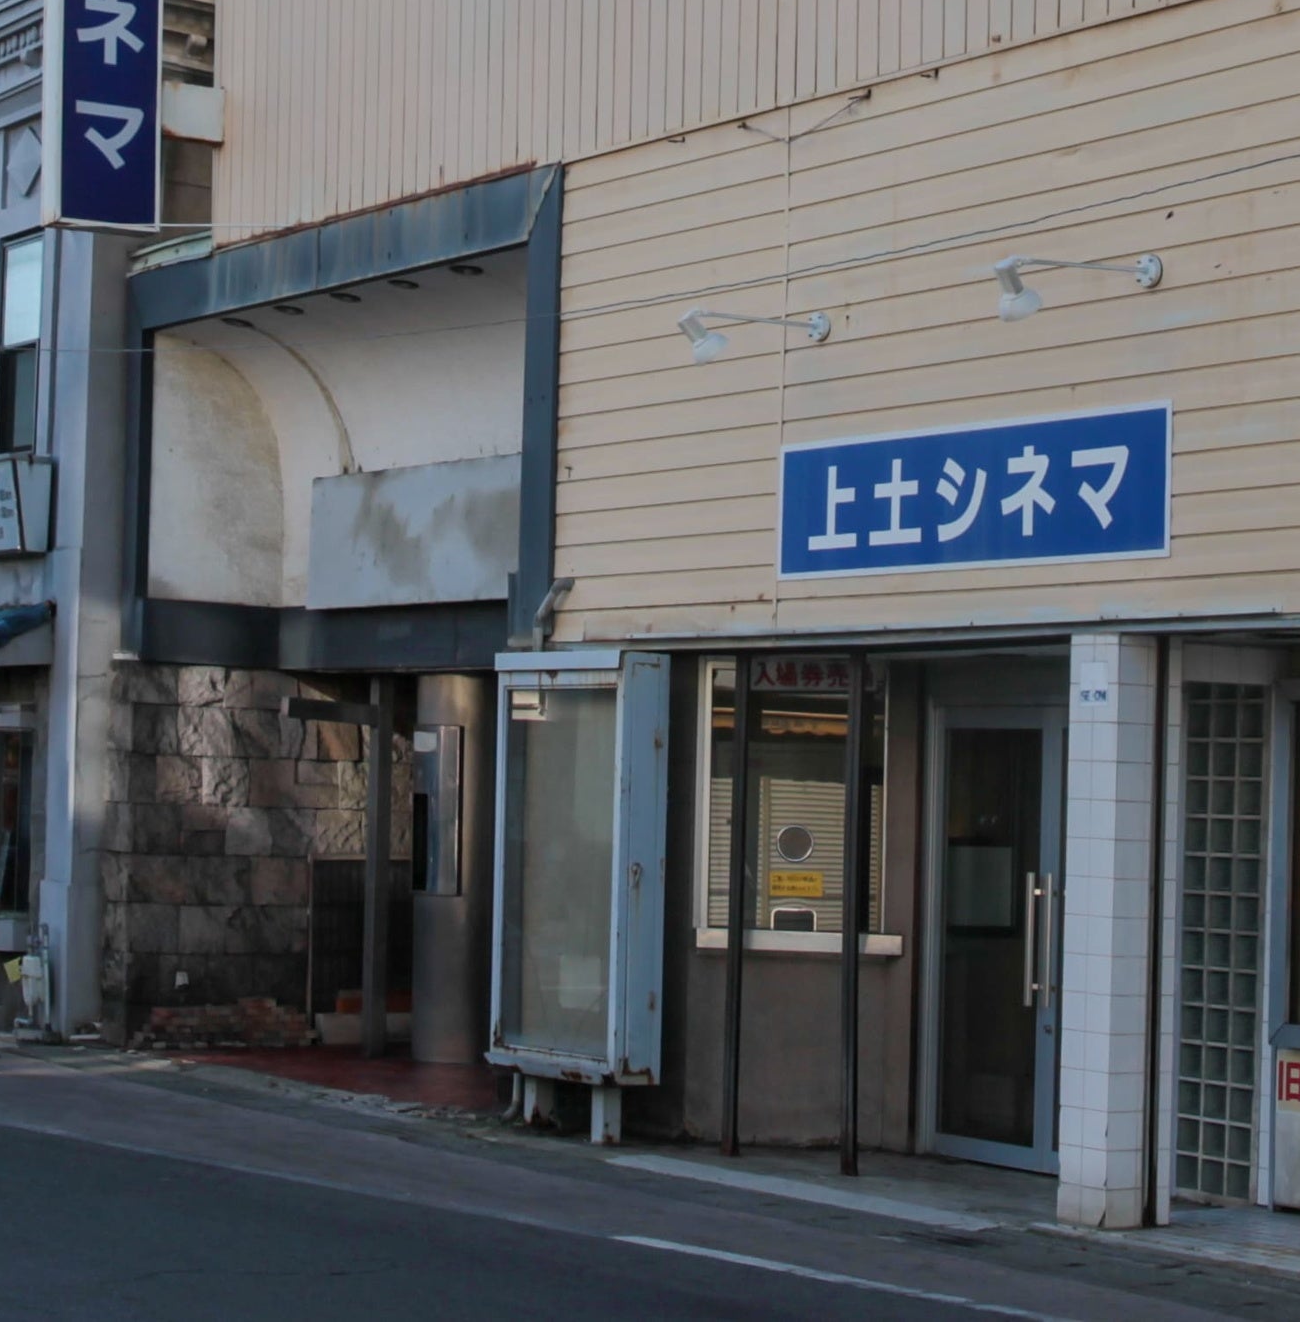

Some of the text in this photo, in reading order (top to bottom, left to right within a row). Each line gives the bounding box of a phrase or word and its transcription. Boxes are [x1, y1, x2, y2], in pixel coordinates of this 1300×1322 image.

[808, 444, 1130, 551] 上土シネマ
